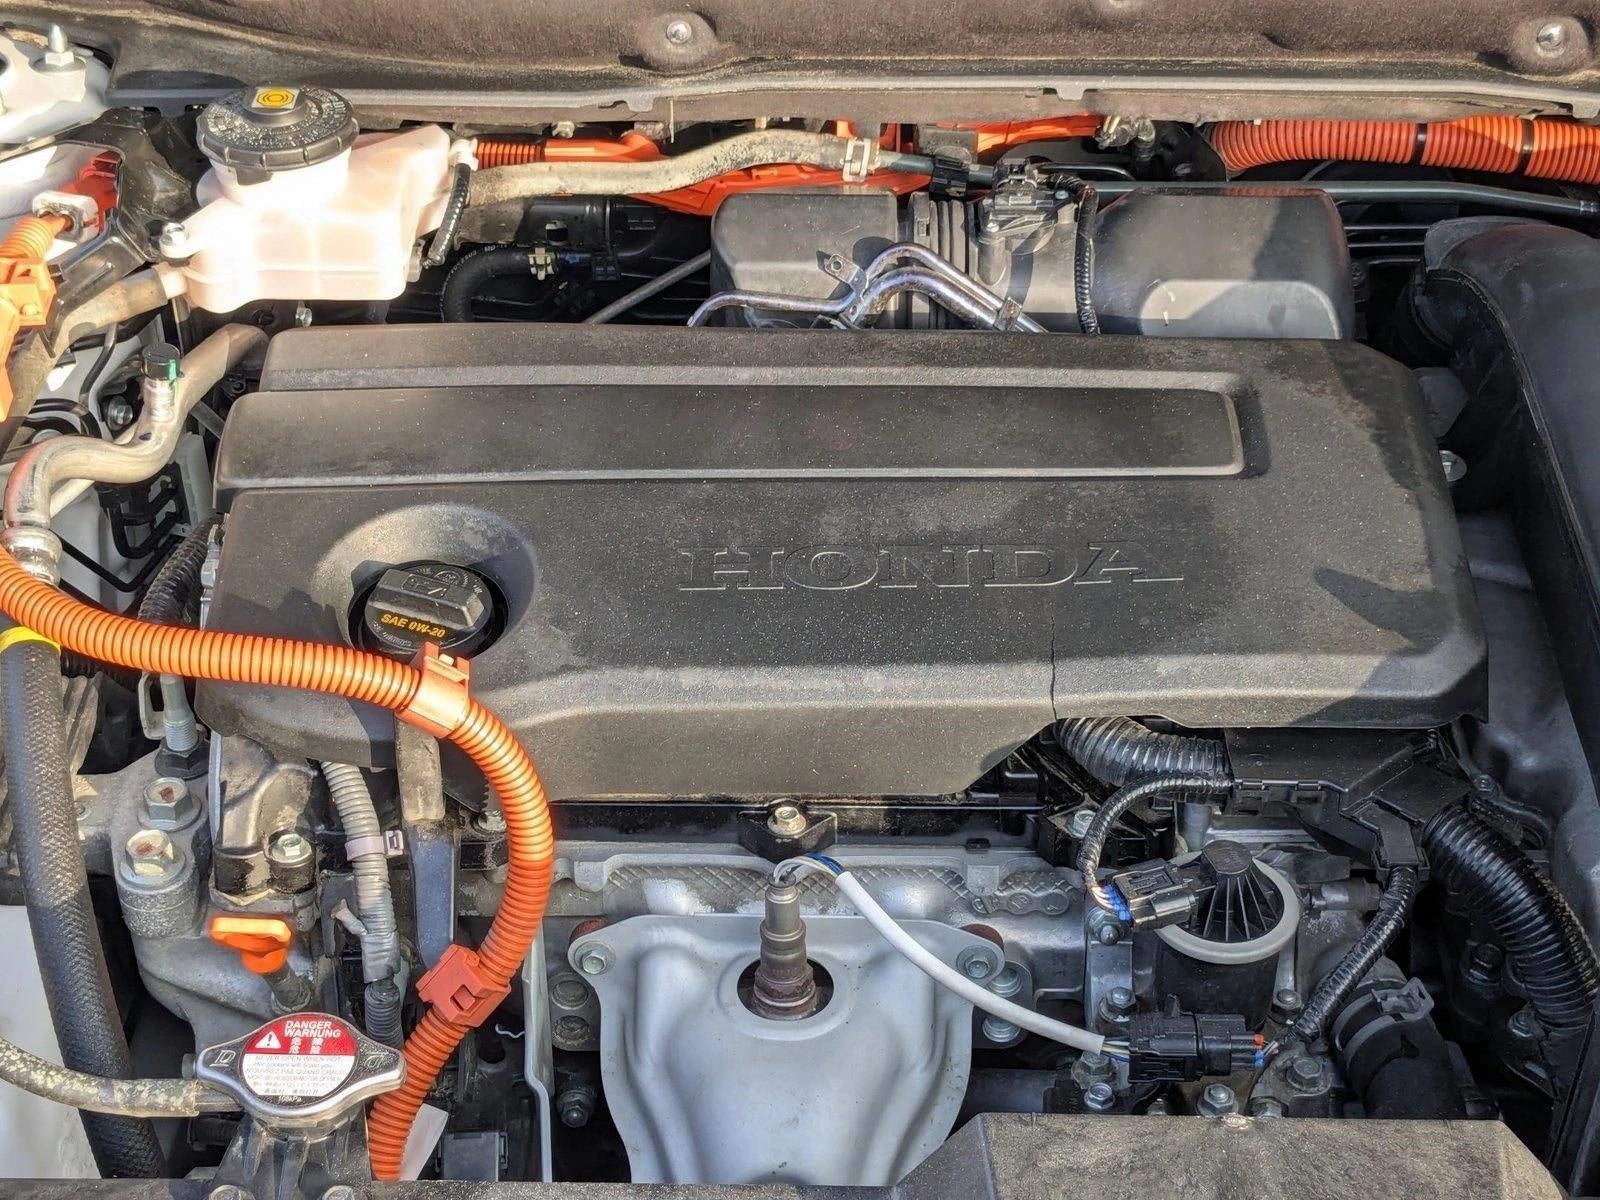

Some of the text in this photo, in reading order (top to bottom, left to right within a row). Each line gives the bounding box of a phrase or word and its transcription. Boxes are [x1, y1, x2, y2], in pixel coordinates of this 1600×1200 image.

[680, 540, 1184, 591] HONDA
[380, 613, 408, 628] SAE
[408, 621, 446, 638] 0W-20
[284, 1028, 342, 1038] WARNUNG
[286, 1020, 332, 1030] DANGER
